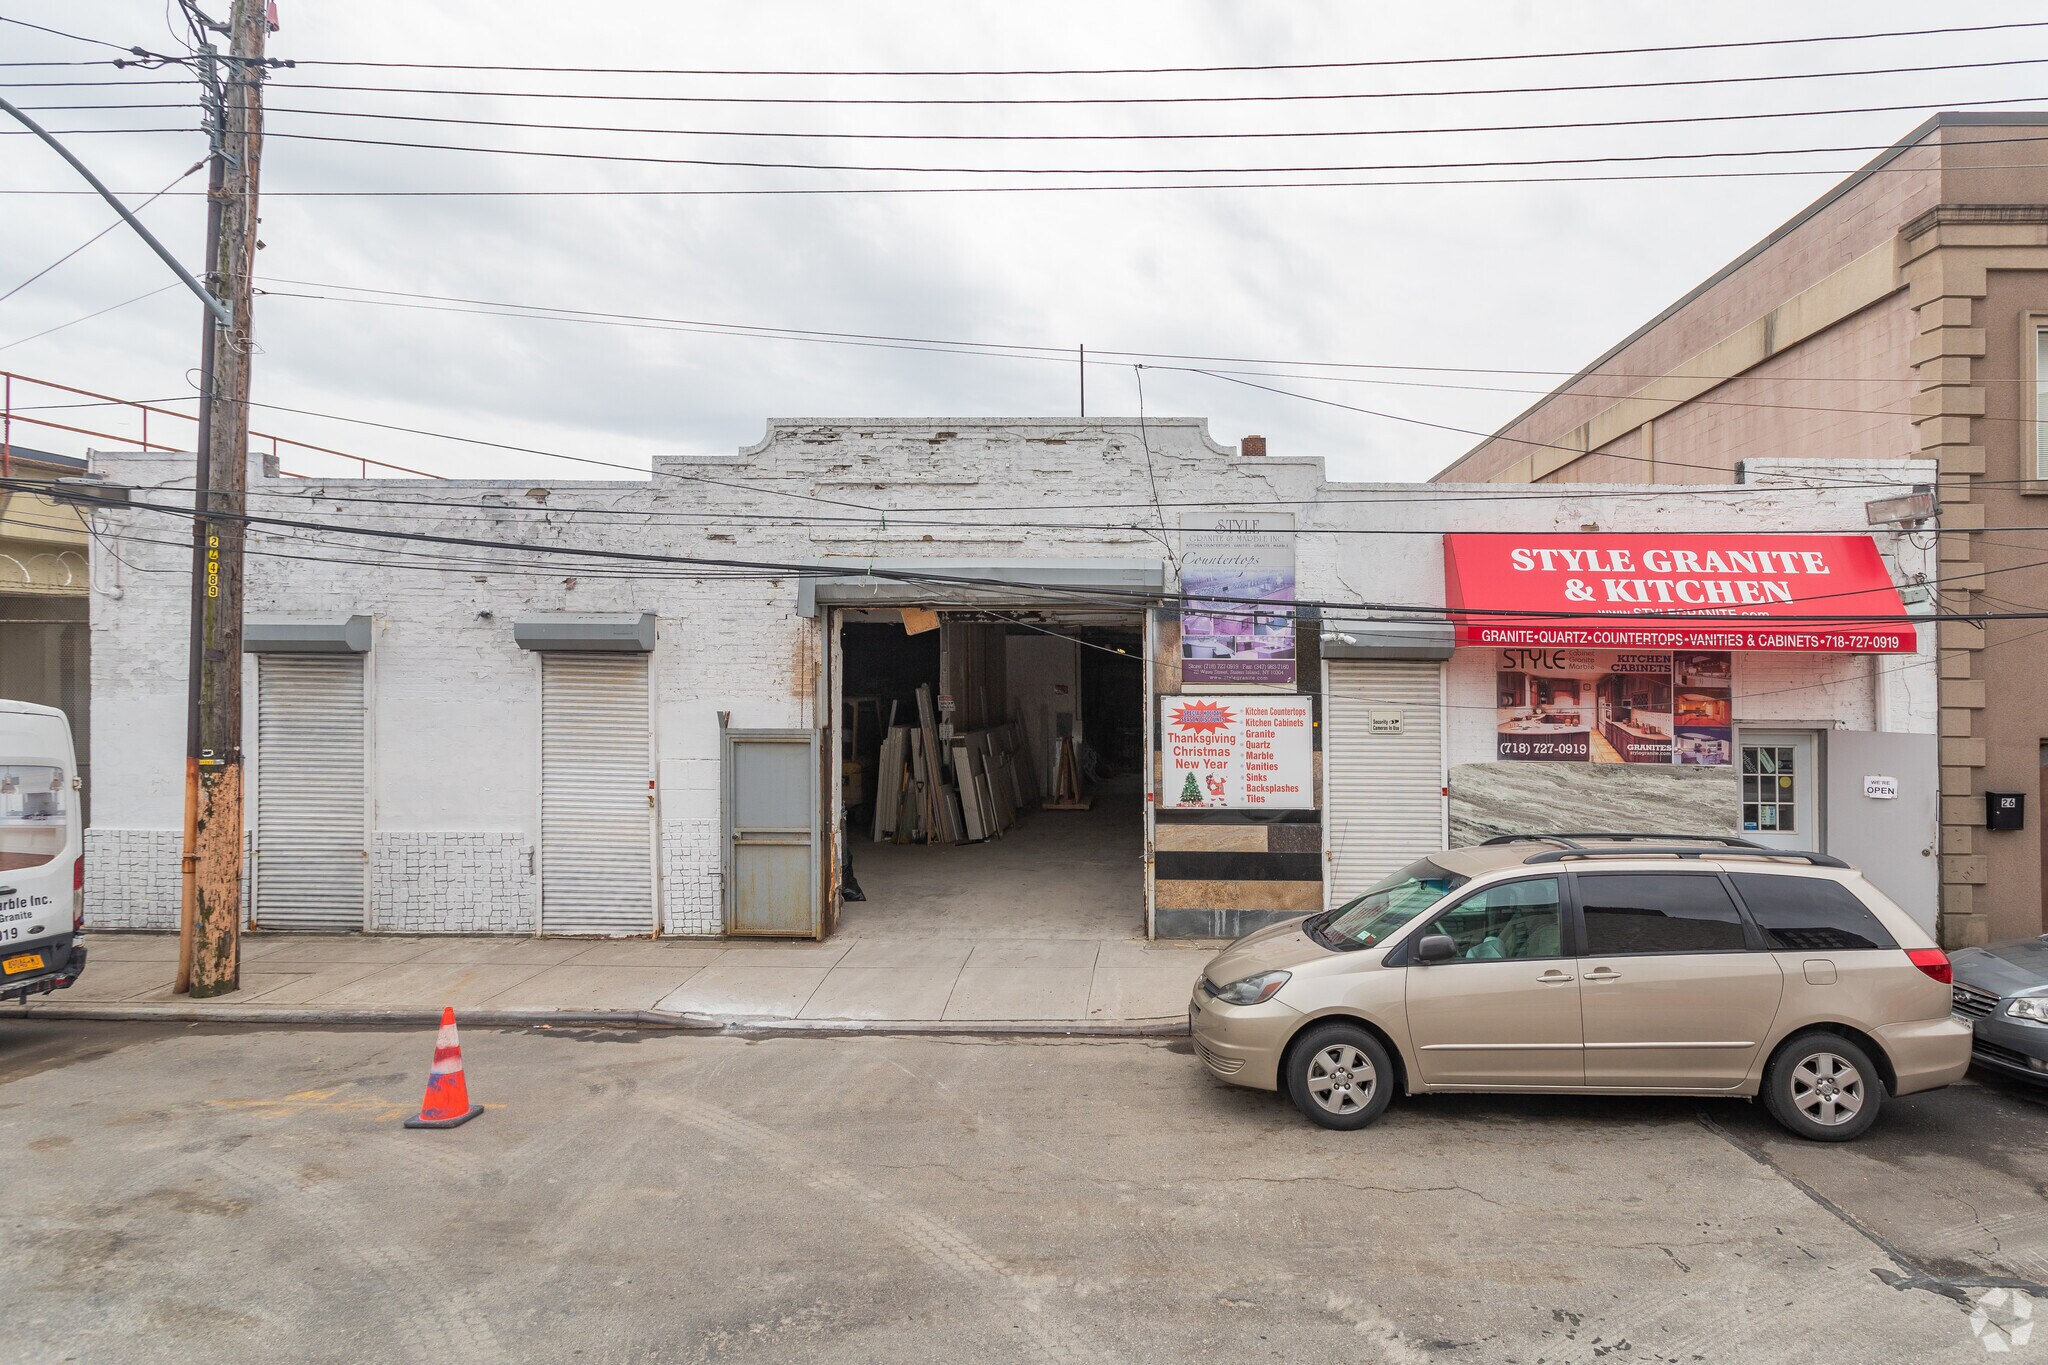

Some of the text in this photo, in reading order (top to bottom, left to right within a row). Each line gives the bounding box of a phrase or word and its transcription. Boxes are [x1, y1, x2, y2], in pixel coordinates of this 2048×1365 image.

[1215, 519, 1260, 534] STYLE
[1236, 535, 1267, 543] MARBLE
[1181, 551, 1261, 577] Countertops
[1511, 548, 1831, 575] STYLE GRANITE
[1564, 578, 1794, 604] & KITCHEN
[1482, 630, 1900, 649] GRANITE QUARTZ COUNTERTOPS VANITIES & CABINETS 718-727-0919
[1503, 649, 1566, 670] STYLE
[1617, 654, 1672, 663] KITCHEN
[1610, 663, 1672, 673] CABINETS
[1245, 707, 1306, 717] Kitchen Countertops
[1245, 718, 1304, 727] Kitchen Cabinets
[1246, 729, 1275, 738] Granite
[1168, 733, 1236, 746] Thanksgiving
[1246, 741, 1271, 750] Quartz
[1500, 742, 1587, 755] (718) 727-0919
[1173, 746, 1231, 757] Christmas
[1246, 752, 1274, 760] Marble
[1175, 758, 1228, 769] New Year
[1246, 762, 1279, 771] Vanities
[1246, 773, 1268, 782] Sinks
[1246, 784, 1299, 793] Backsplashes
[1866, 786, 1895, 795] OPEN
[1246, 794, 1266, 803] Tiles
[2002, 799, 2014, 807] 26
[30, 895, 53, 907] Inc.
[0, 927, 18, 942] 19
